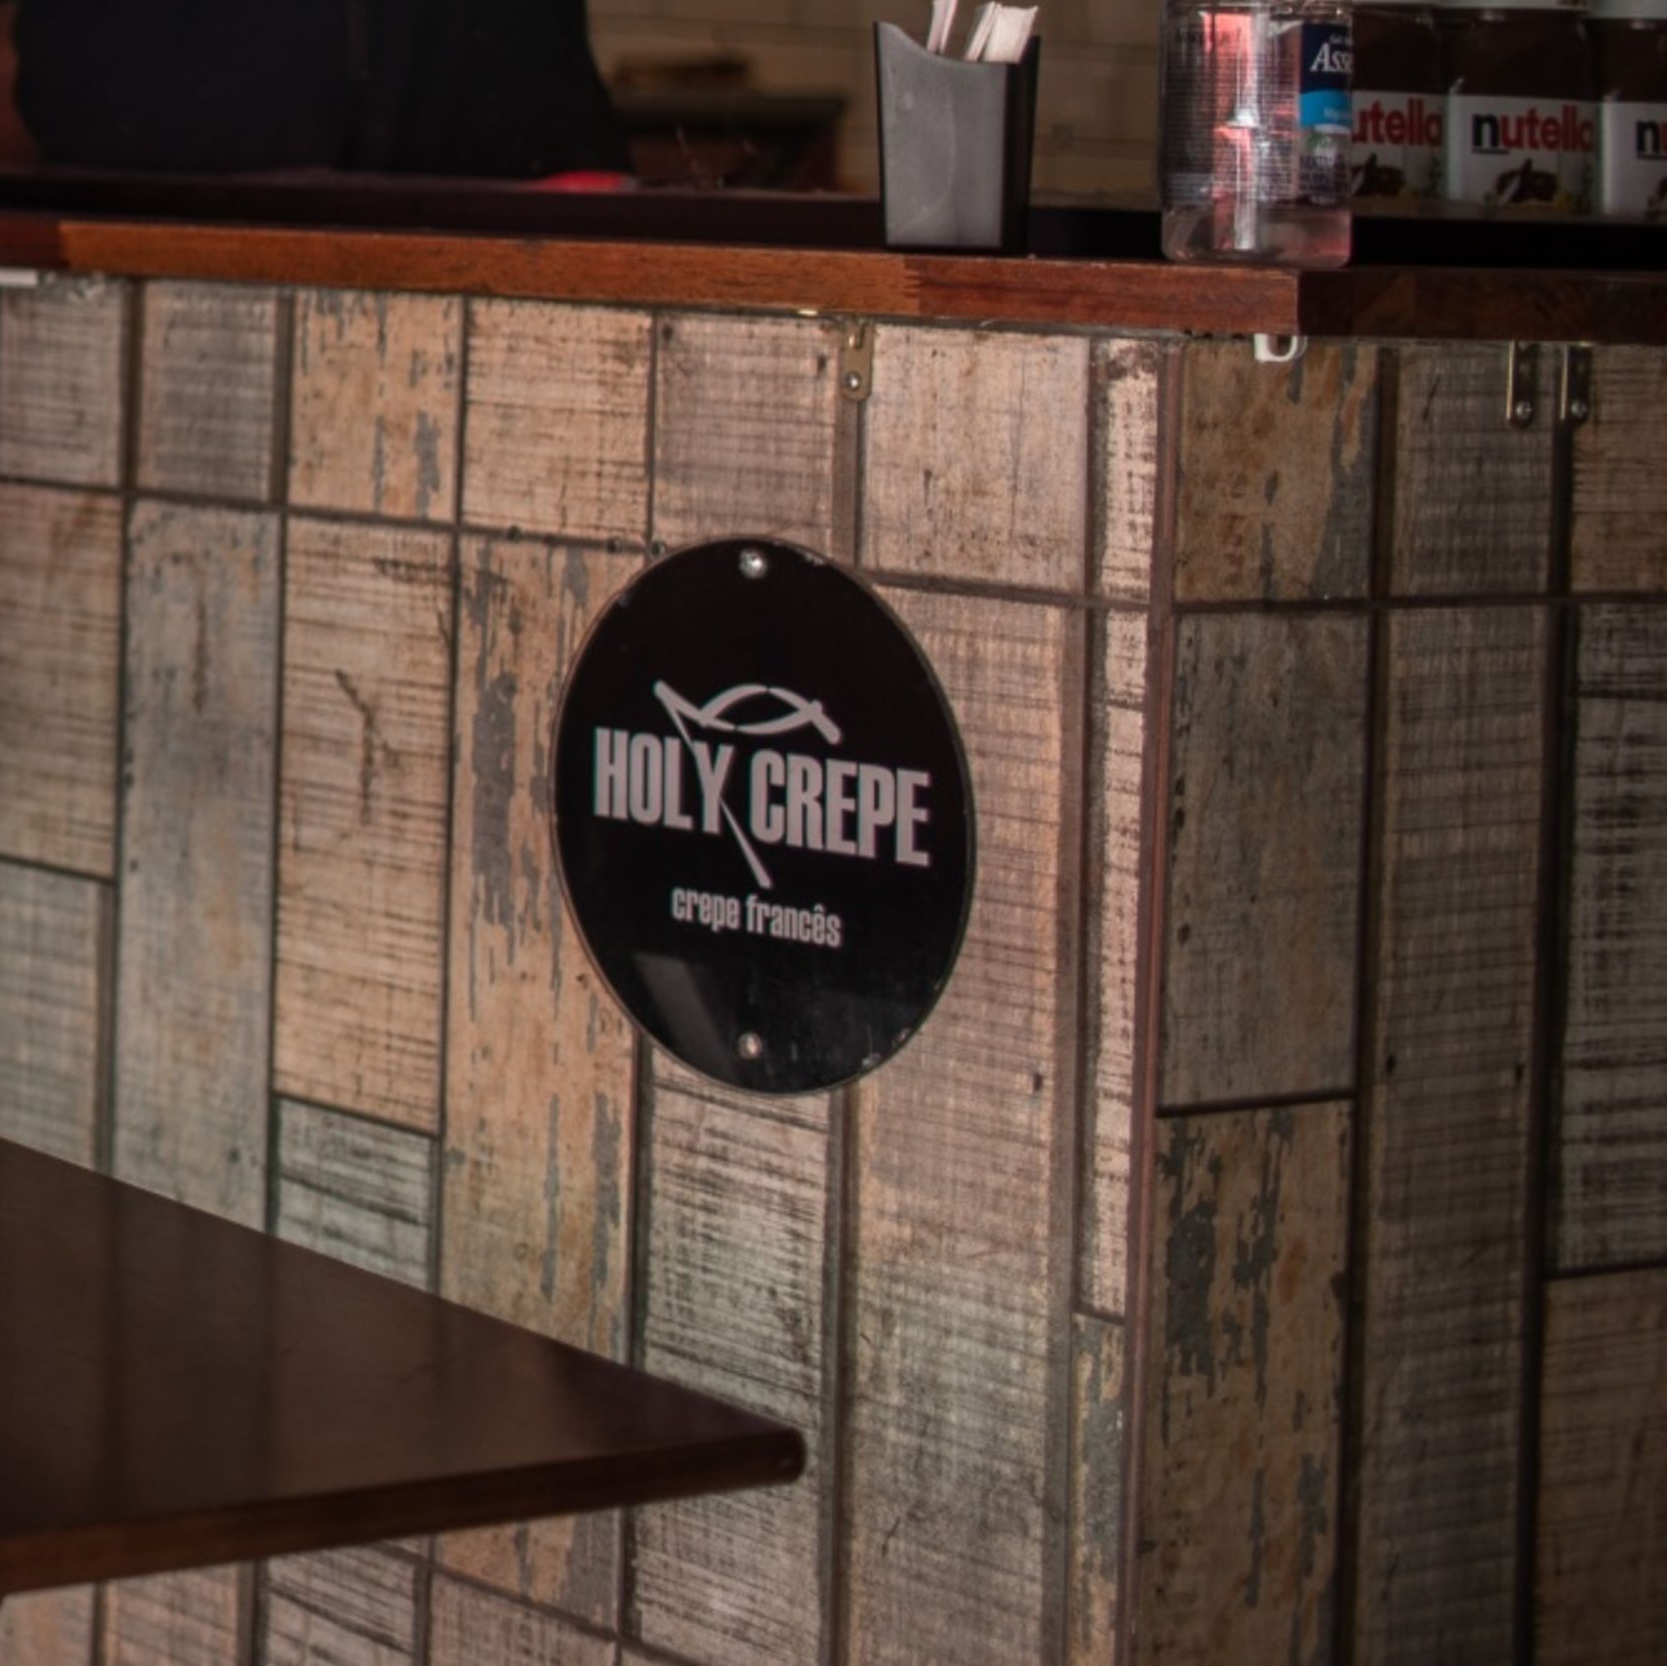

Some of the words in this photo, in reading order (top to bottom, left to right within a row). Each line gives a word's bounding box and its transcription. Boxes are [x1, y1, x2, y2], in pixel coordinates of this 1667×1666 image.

[1472, 104, 1595, 153] nutella
[591, 727, 735, 835] HOLY
[750, 749, 931, 867] CREPE
[672, 887, 741, 932] crepe
[746, 892, 841, 949] francês
